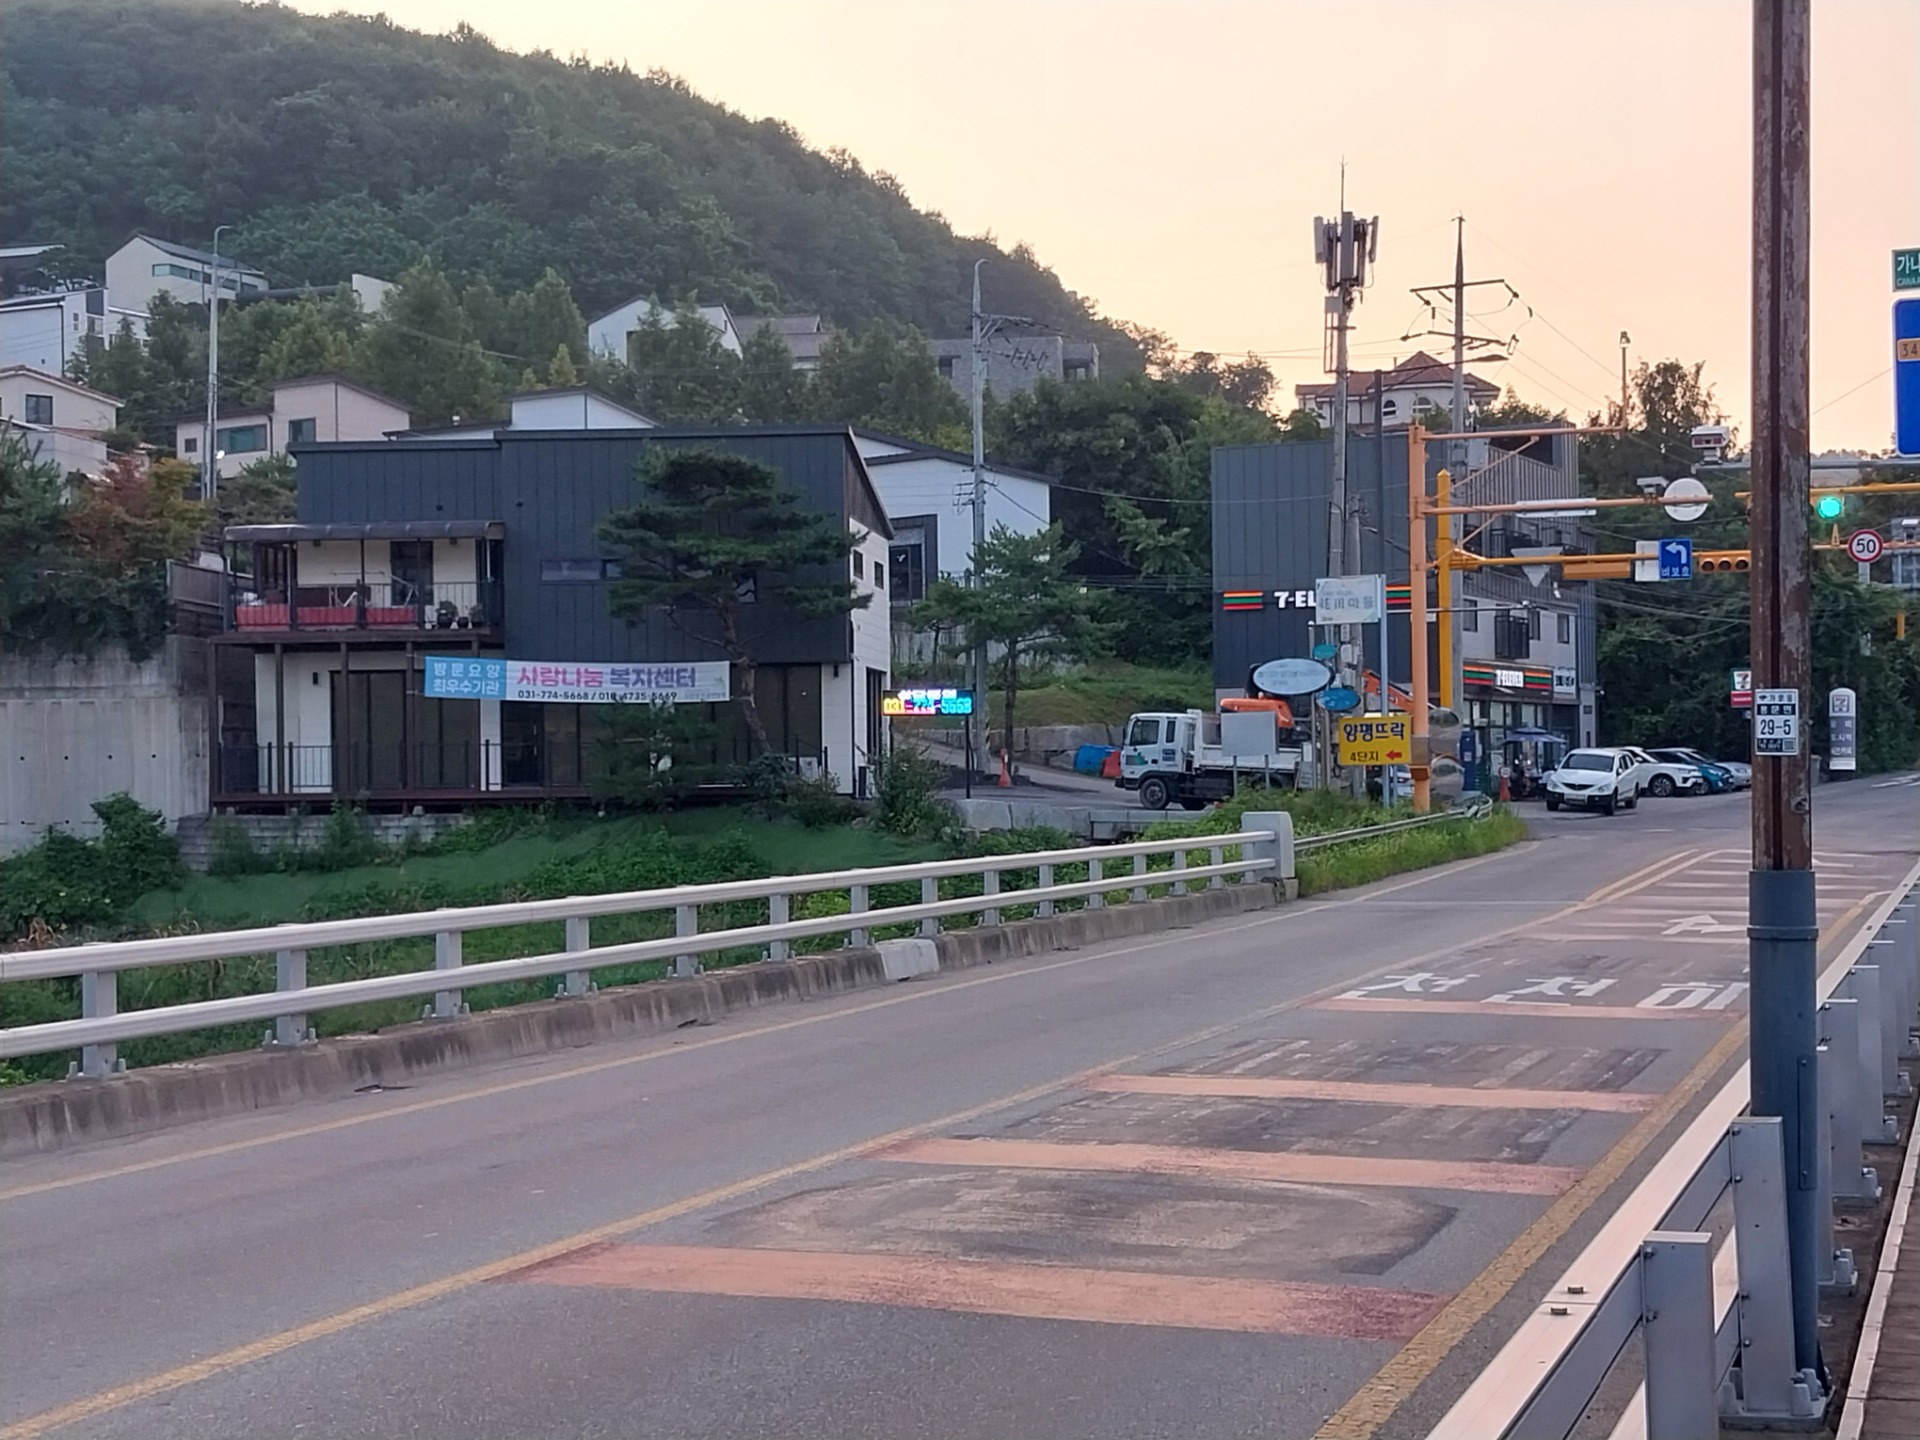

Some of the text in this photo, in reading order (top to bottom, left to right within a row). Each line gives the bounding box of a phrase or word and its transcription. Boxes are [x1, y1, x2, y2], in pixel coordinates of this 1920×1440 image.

[1856, 538, 1877, 553] 50
[1660, 566, 1690, 577] 비보호
[517, 666, 696, 688] 사랑나눔 복지센터
[433, 679, 500, 695] 최우수기관
[517, 690, 589, 701] 031-774-5668
[1343, 721, 1405, 742] 양평뜨락
[1760, 719, 1792, 735] 29-5
[1350, 751, 1379, 762] 4단지
